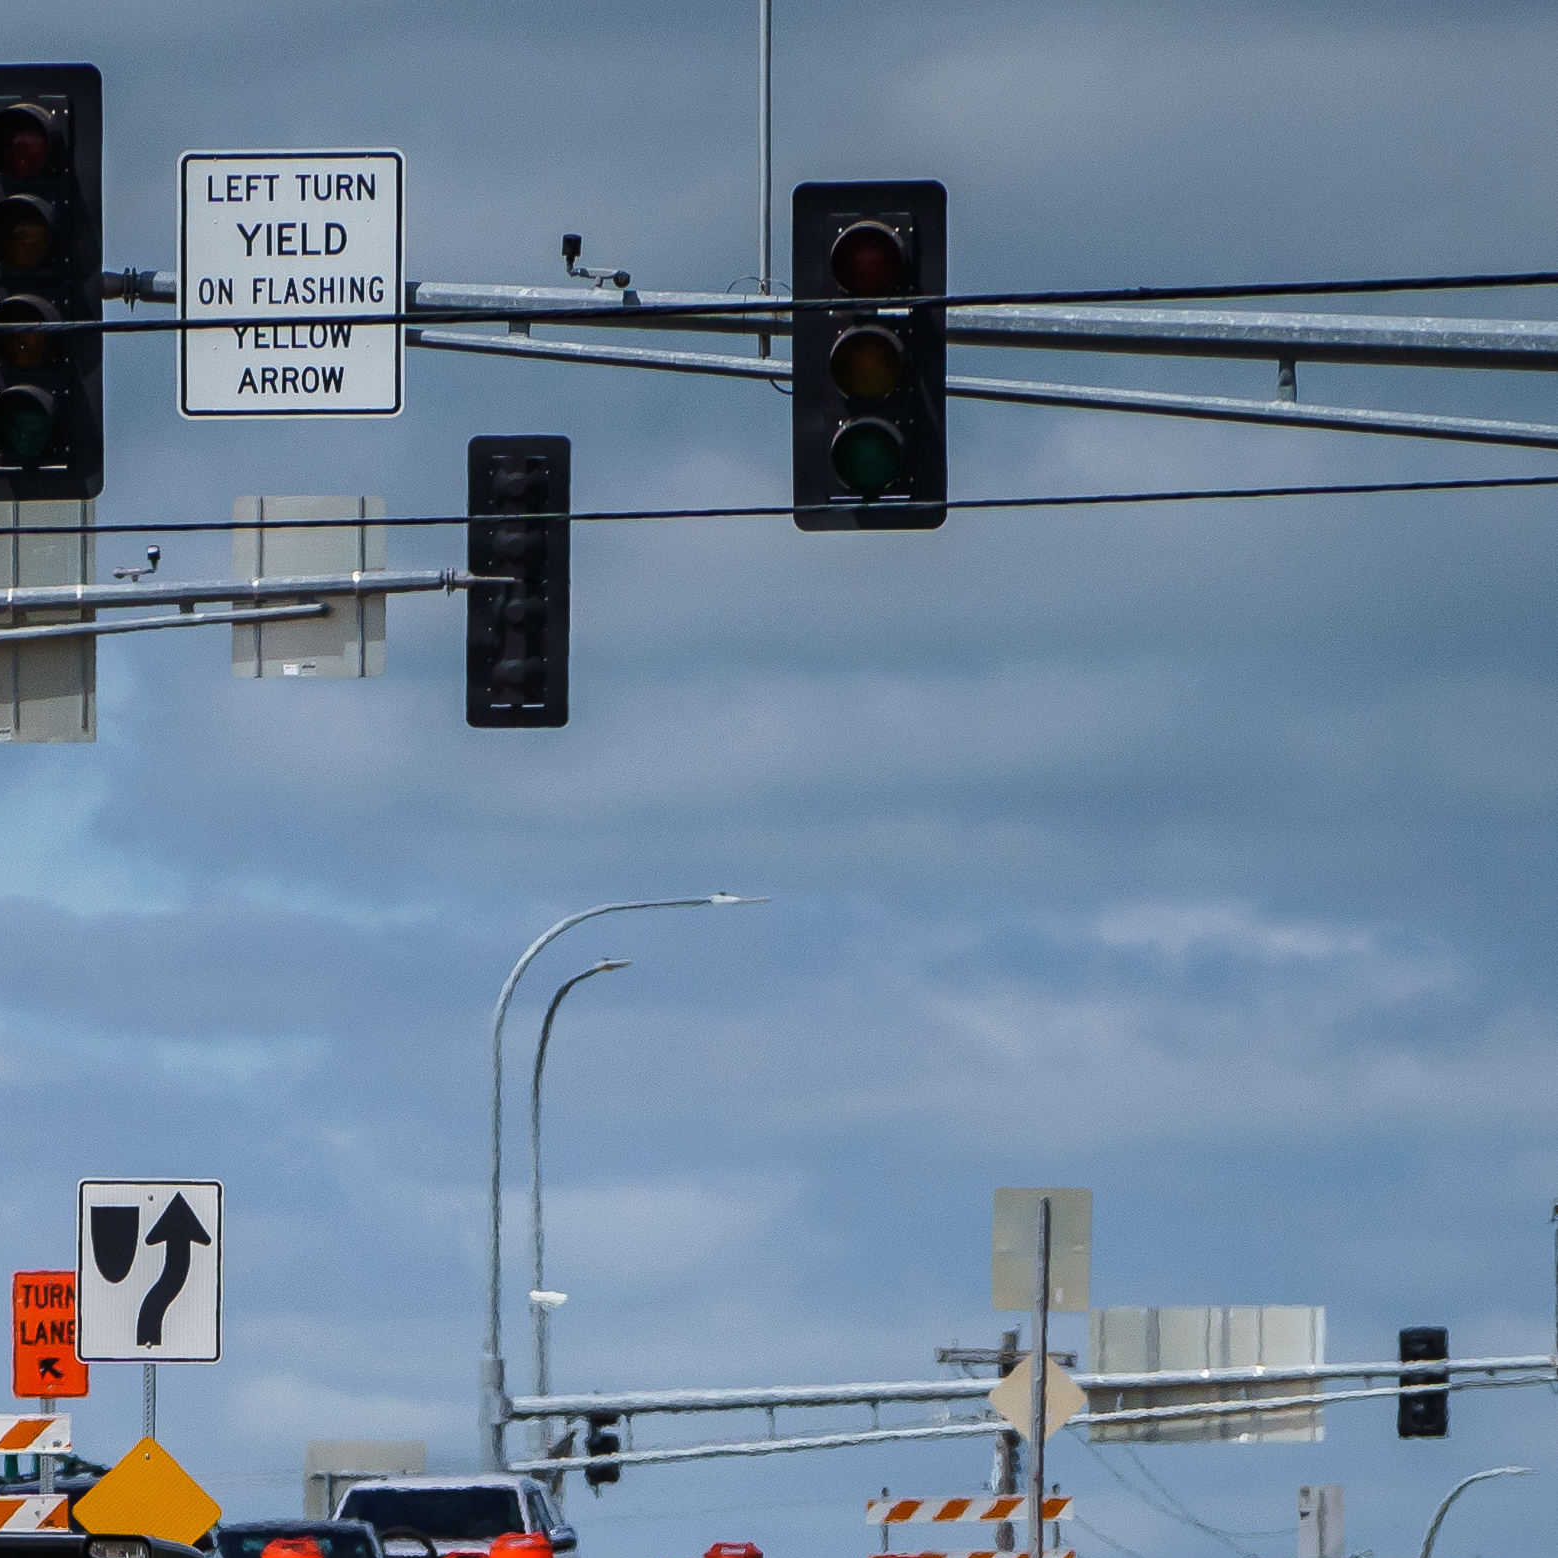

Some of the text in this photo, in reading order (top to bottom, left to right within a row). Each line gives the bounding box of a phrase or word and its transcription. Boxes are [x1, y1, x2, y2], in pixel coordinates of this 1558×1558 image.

[207, 173, 376, 202] LEFT TURN
[236, 222, 348, 257] YIELD
[198, 276, 384, 305] ON FLASHING
[233, 322, 353, 349] YELLOW
[237, 366, 345, 394] ARROW
[22, 1284, 76, 1309] TURN
[20, 1320, 76, 1345] LANE
